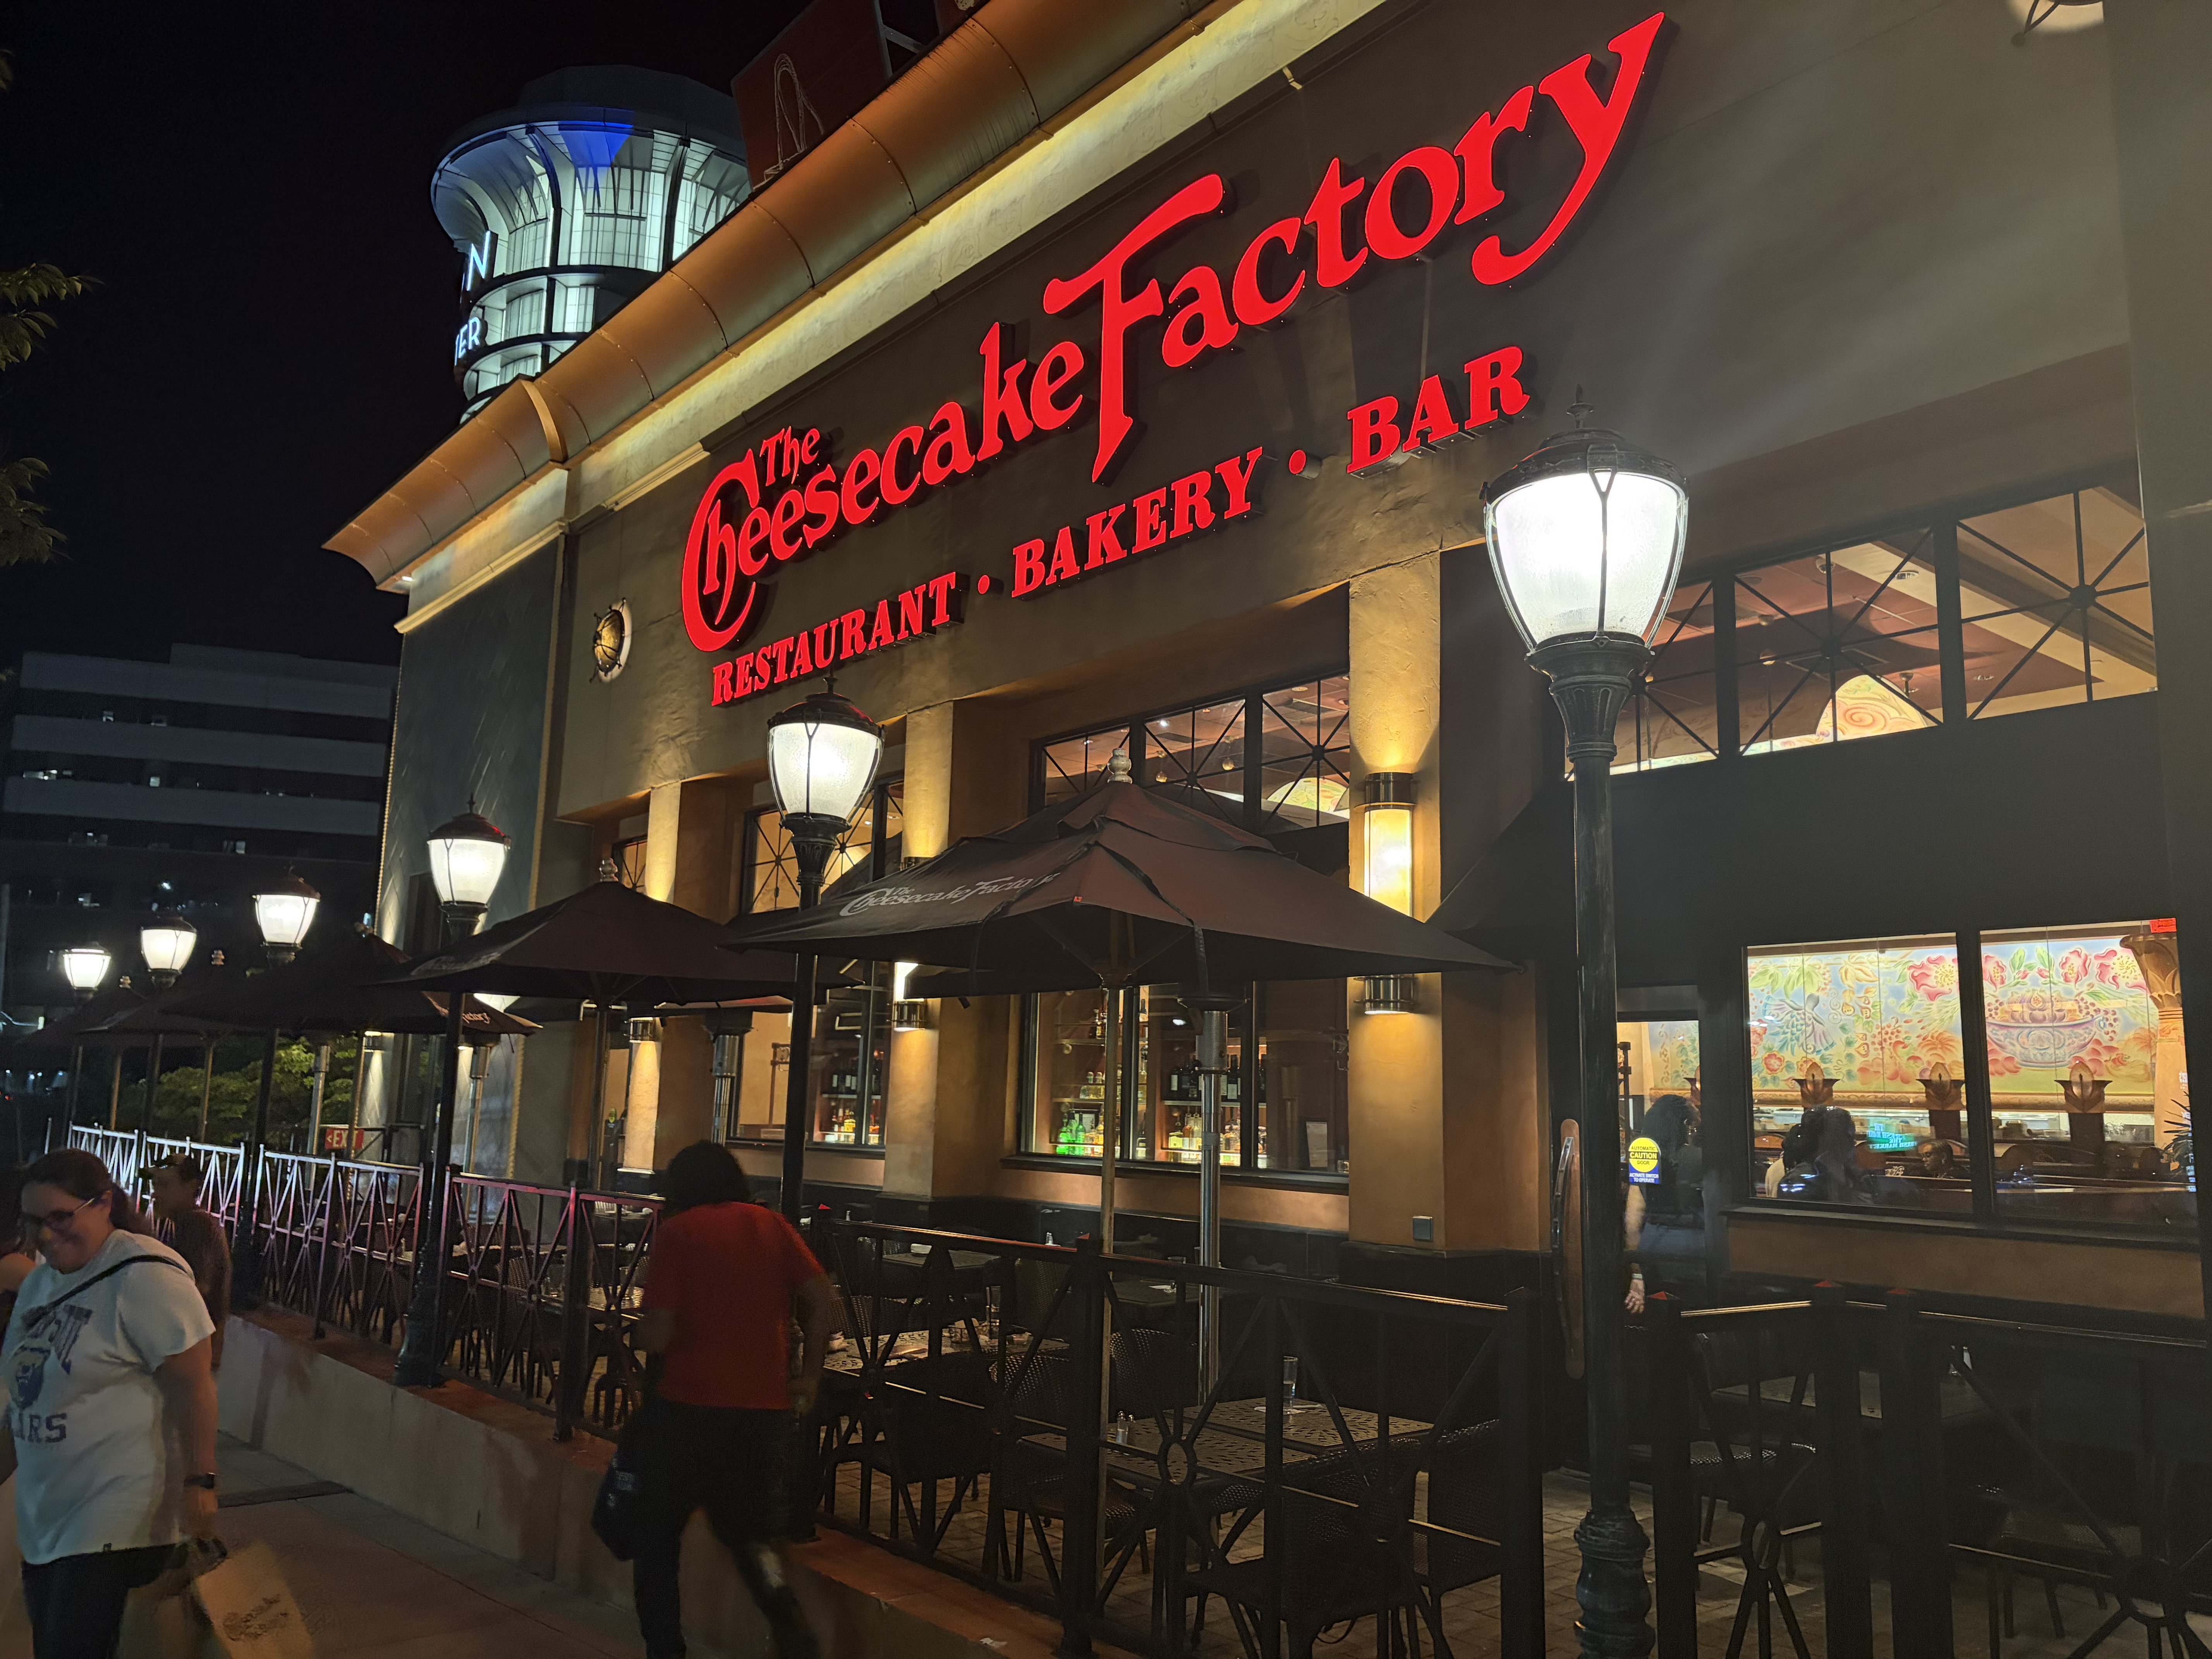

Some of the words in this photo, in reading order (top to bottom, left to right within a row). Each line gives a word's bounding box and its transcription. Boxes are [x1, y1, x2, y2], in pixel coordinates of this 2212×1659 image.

[1043, 12, 1665, 483] Factory
[681, 321, 1085, 652] Cheesecake
[711, 572, 956, 706] RESTAURANT
[1012, 447, 1262, 598] BAKERY
[1347, 347, 1530, 473] BAR
[759, 426, 821, 486] The
[839, 885, 971, 917] Cheesecake
[893, 886, 915, 895] The
